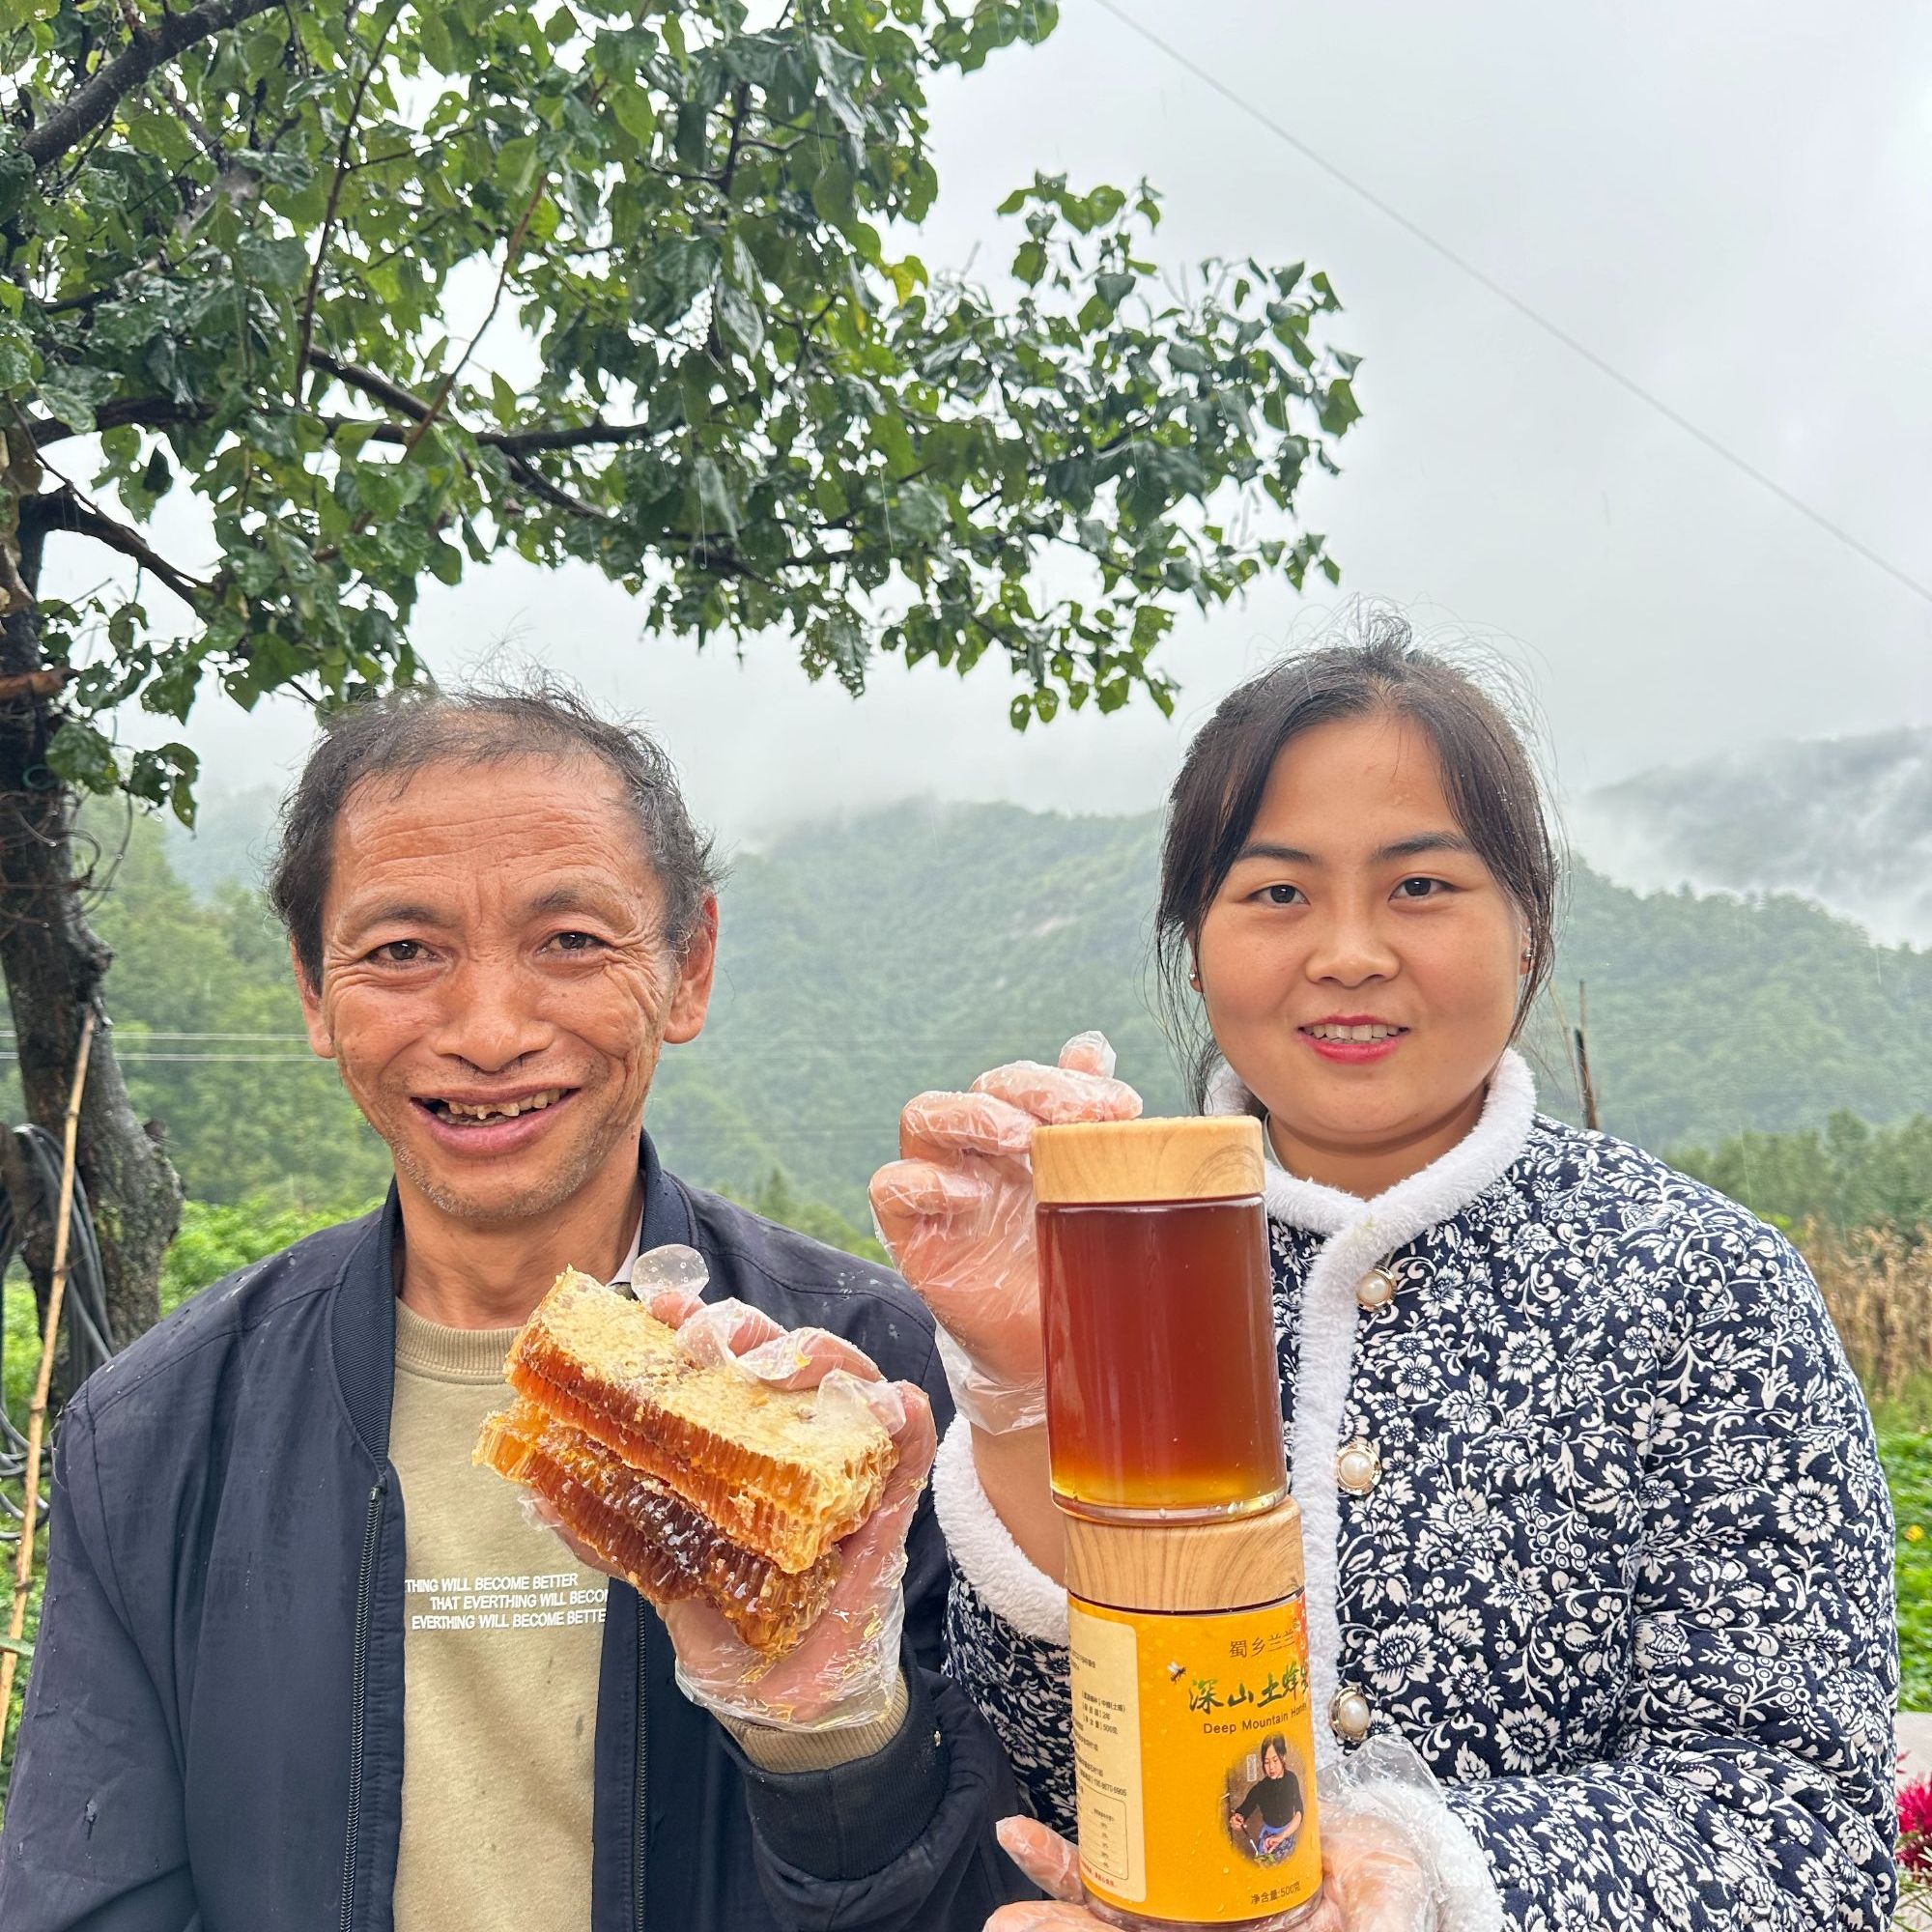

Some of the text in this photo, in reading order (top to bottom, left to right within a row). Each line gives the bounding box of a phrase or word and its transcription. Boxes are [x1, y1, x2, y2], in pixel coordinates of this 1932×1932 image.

[441, 1577, 471, 1592] WILL
[475, 1576, 530, 1591] BECOME
[533, 1573, 579, 1590] BETTER
[430, 1596, 462, 1611] THAT
[464, 1594, 537, 1610] EVERTHING
[540, 1592, 567, 1607] WILL
[412, 1614, 476, 1631] EVERTHING
[479, 1613, 510, 1629] WILL
[513, 1611, 565, 1628] BECOME
[1204, 1722, 1236, 1734] Deep
[1242, 1713, 1289, 1731] Mountain
